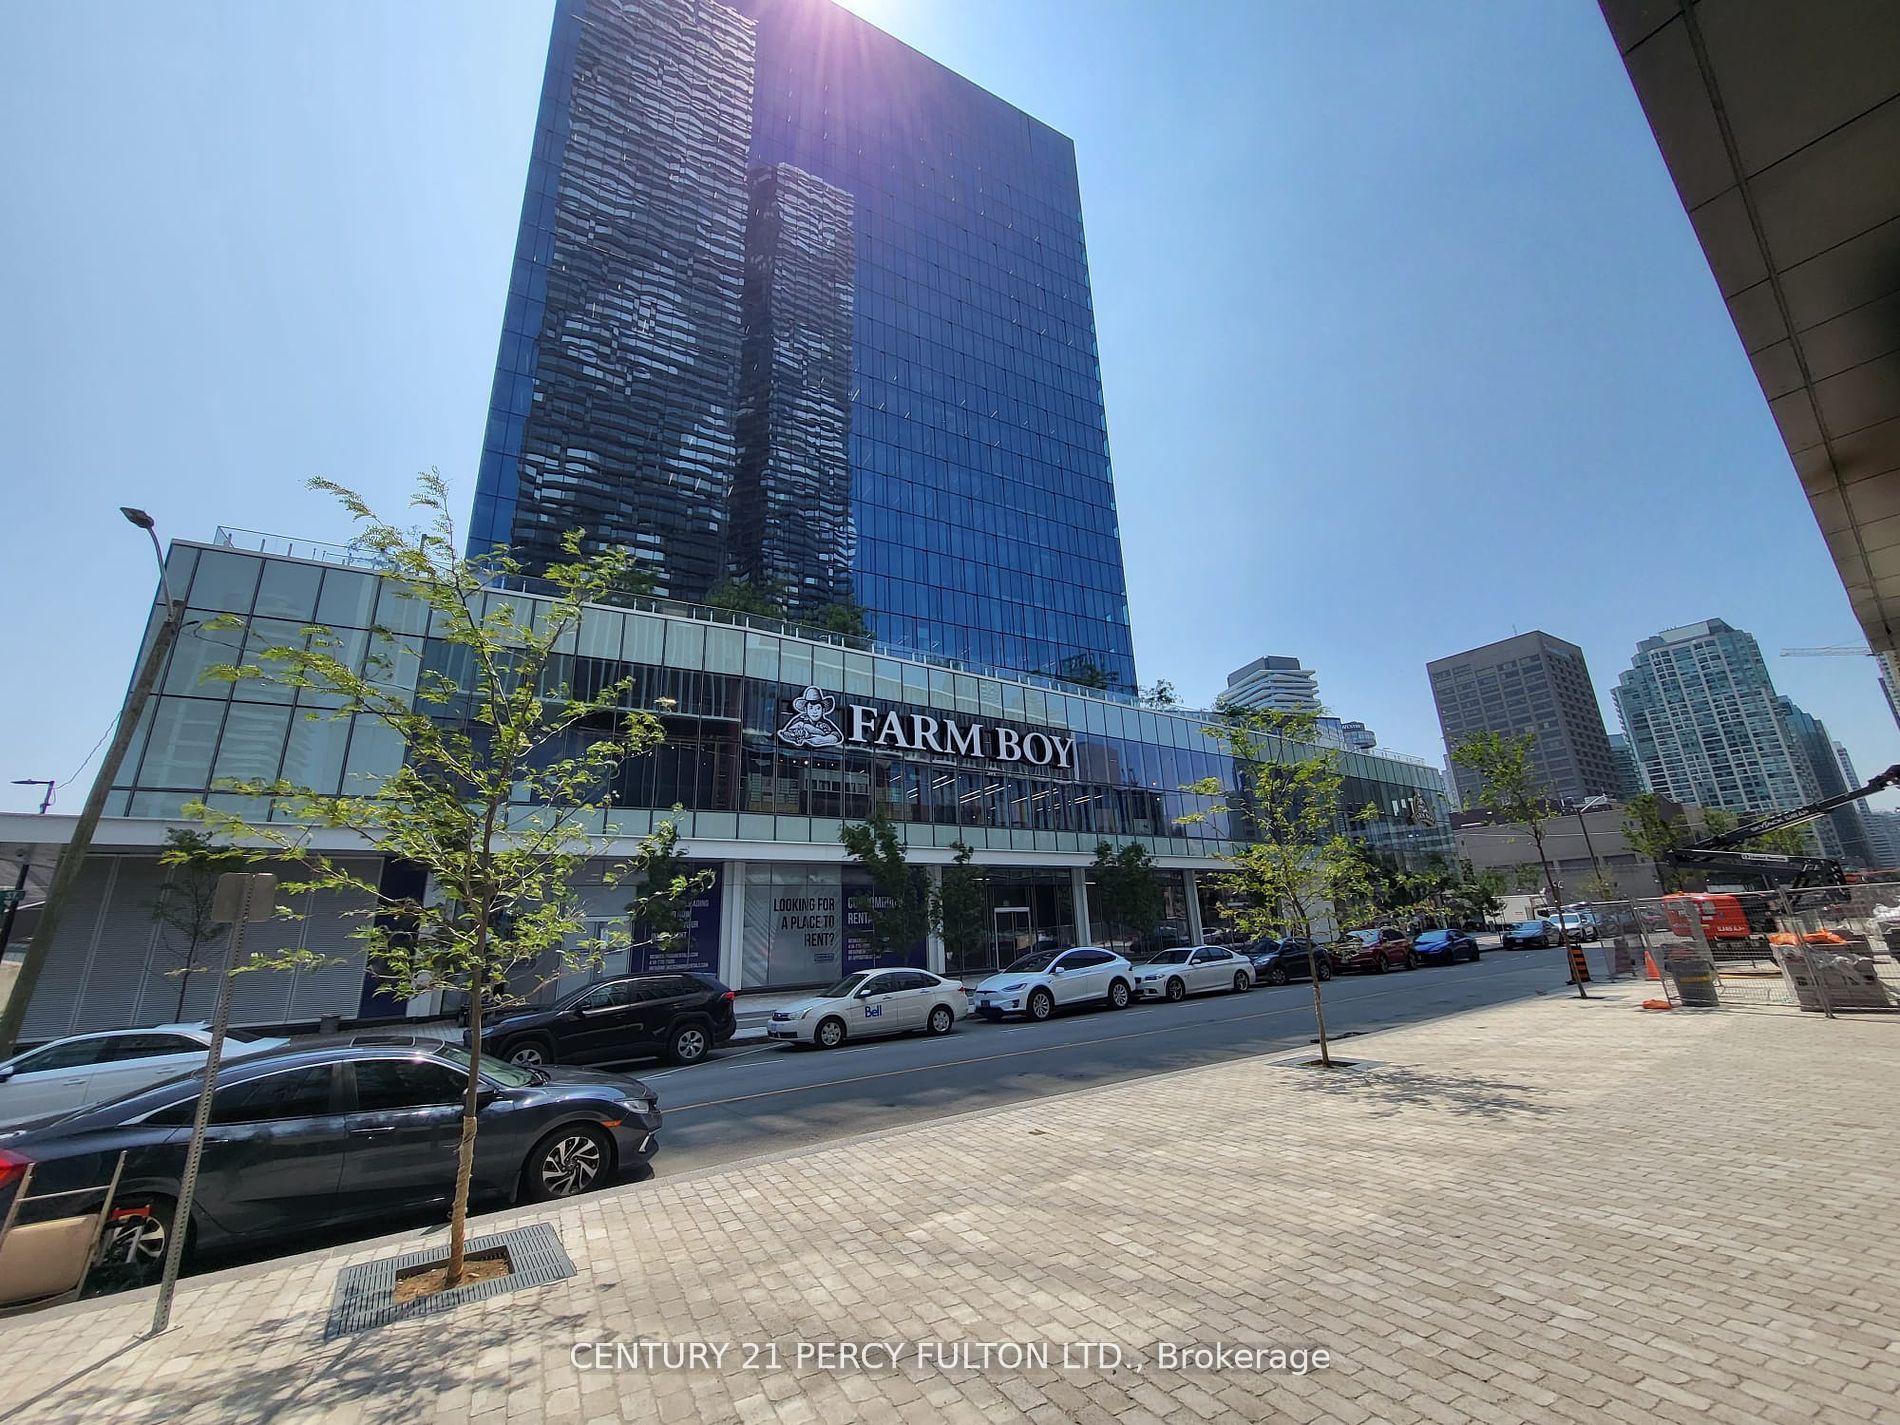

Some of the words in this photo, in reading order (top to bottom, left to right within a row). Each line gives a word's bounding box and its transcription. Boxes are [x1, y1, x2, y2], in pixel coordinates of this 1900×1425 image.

[848, 704, 985, 758] FARM
[995, 727, 1074, 768] BOY
[774, 898, 815, 911] LOOKING
[818, 898, 834, 911] FOR
[781, 916, 788, 930] A
[791, 915, 821, 929] PLACE
[823, 915, 835, 928] TO
[804, 933, 835, 946] RENT?
[865, 1004, 882, 1018] Bell
